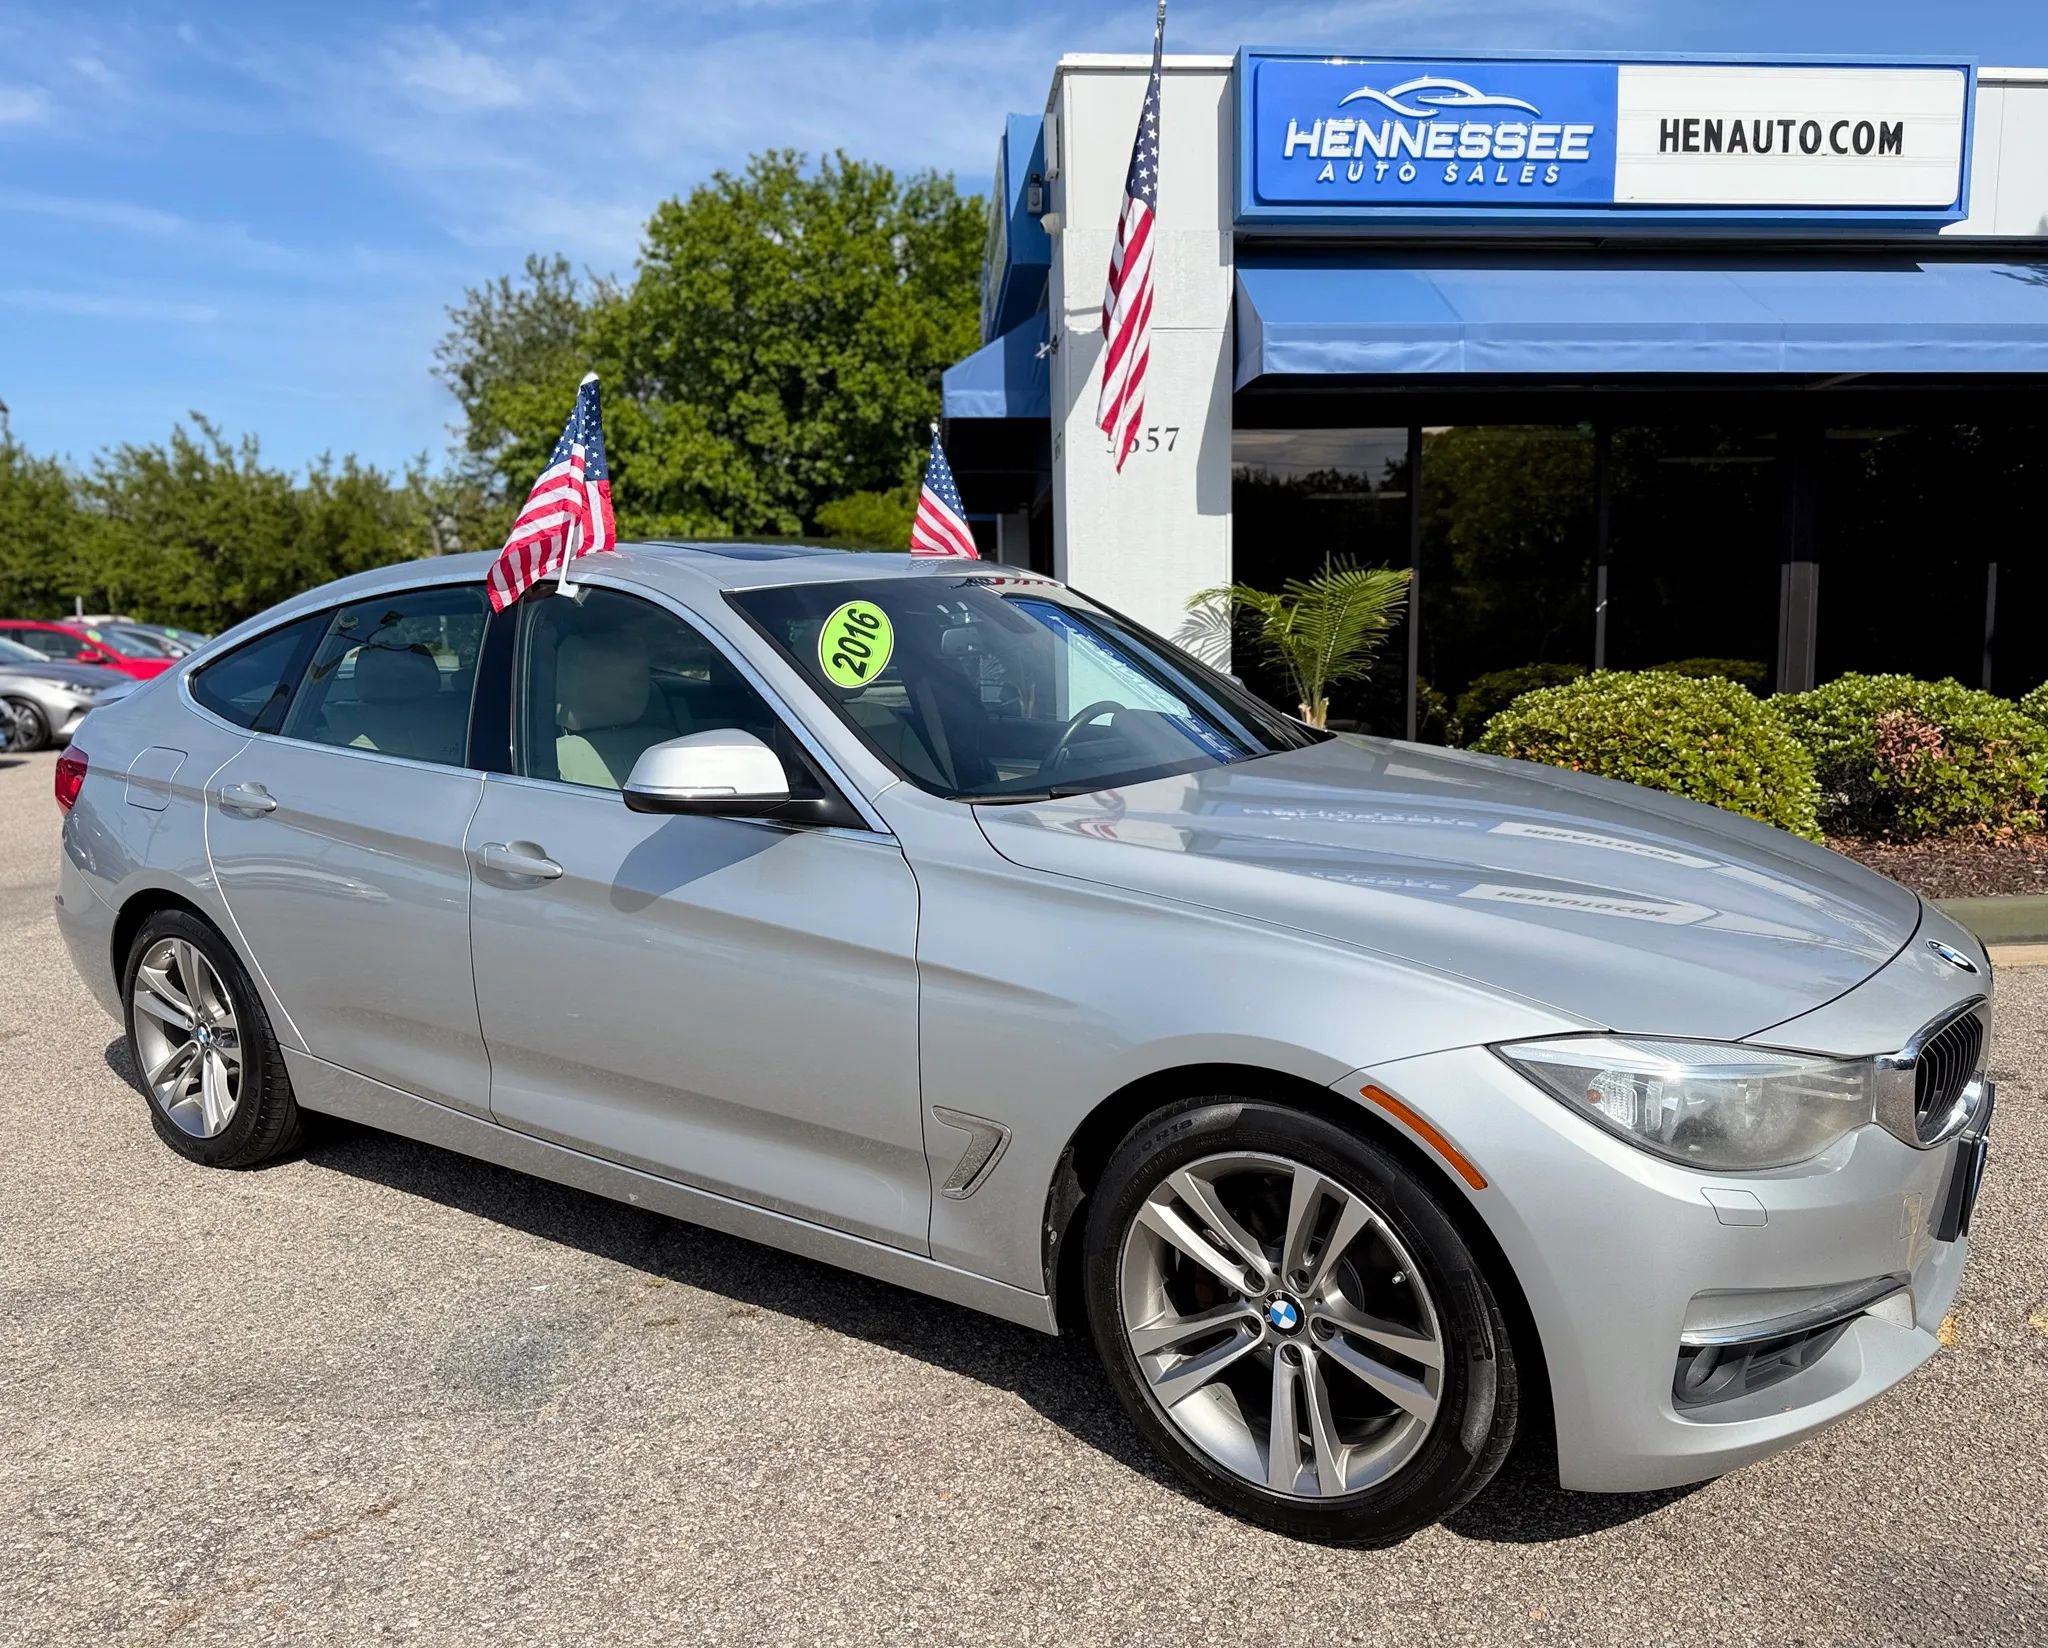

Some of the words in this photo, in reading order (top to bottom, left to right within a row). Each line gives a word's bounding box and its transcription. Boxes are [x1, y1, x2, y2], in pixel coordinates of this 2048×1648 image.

[1283, 119, 1595, 160] HENNESSEE
[1659, 118, 1904, 156] HENAUTO.COM
[1317, 160, 1417, 182] AUTO
[1443, 161, 1560, 184] SALES
[832, 608, 880, 679] 2016
